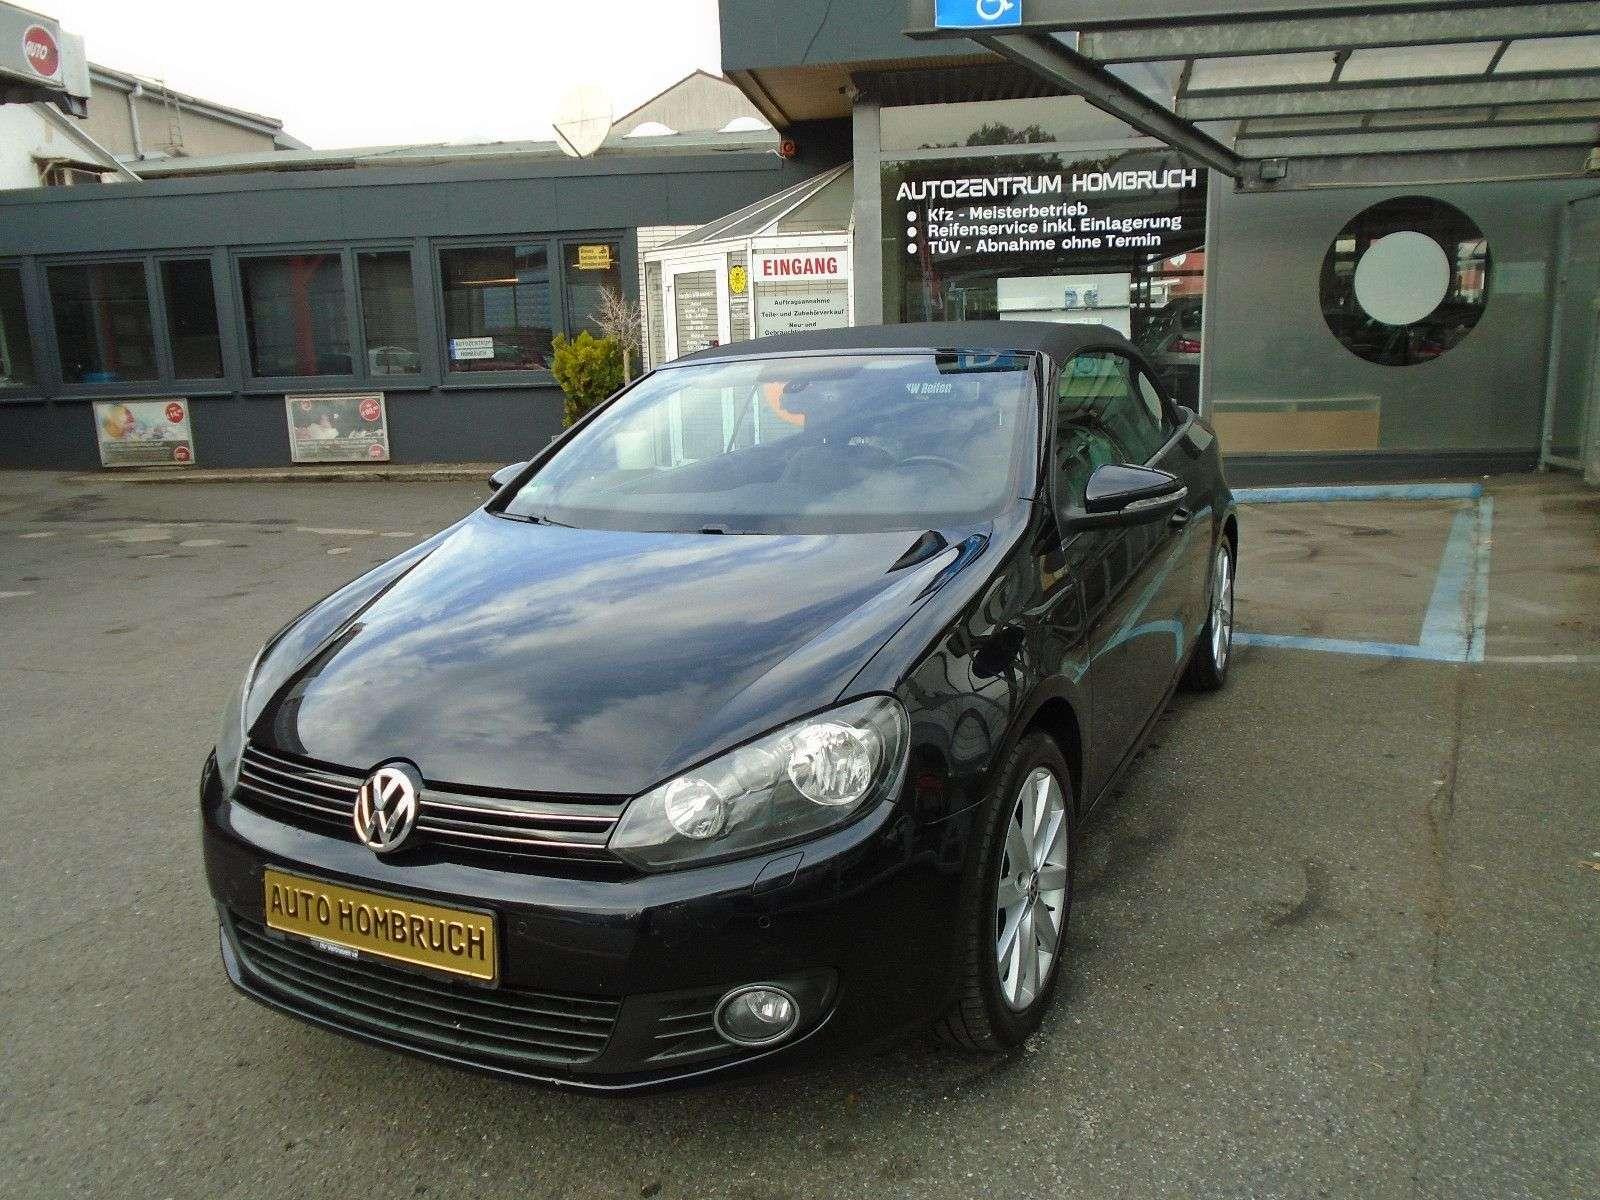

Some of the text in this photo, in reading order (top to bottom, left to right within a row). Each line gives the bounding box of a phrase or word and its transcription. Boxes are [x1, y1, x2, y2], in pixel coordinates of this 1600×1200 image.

[896, 168, 1197, 201] AUTOZENTRUM HOMBRUCH
[927, 207, 954, 222] Kfz
[969, 201, 1088, 220] Meisterbetrieb
[928, 215, 1182, 238] Reifenservice inkl. Einlagerung
[928, 239, 960, 254] TÜV
[975, 237, 1056, 253] Abnahme
[1061, 235, 1102, 250] ohne
[1105, 232, 1162, 248] Termin
[763, 257, 838, 276] EINGANG
[774, 297, 831, 306] Auftragsannahme
[270, 883, 486, 961] AUTO HOMBRUCH
